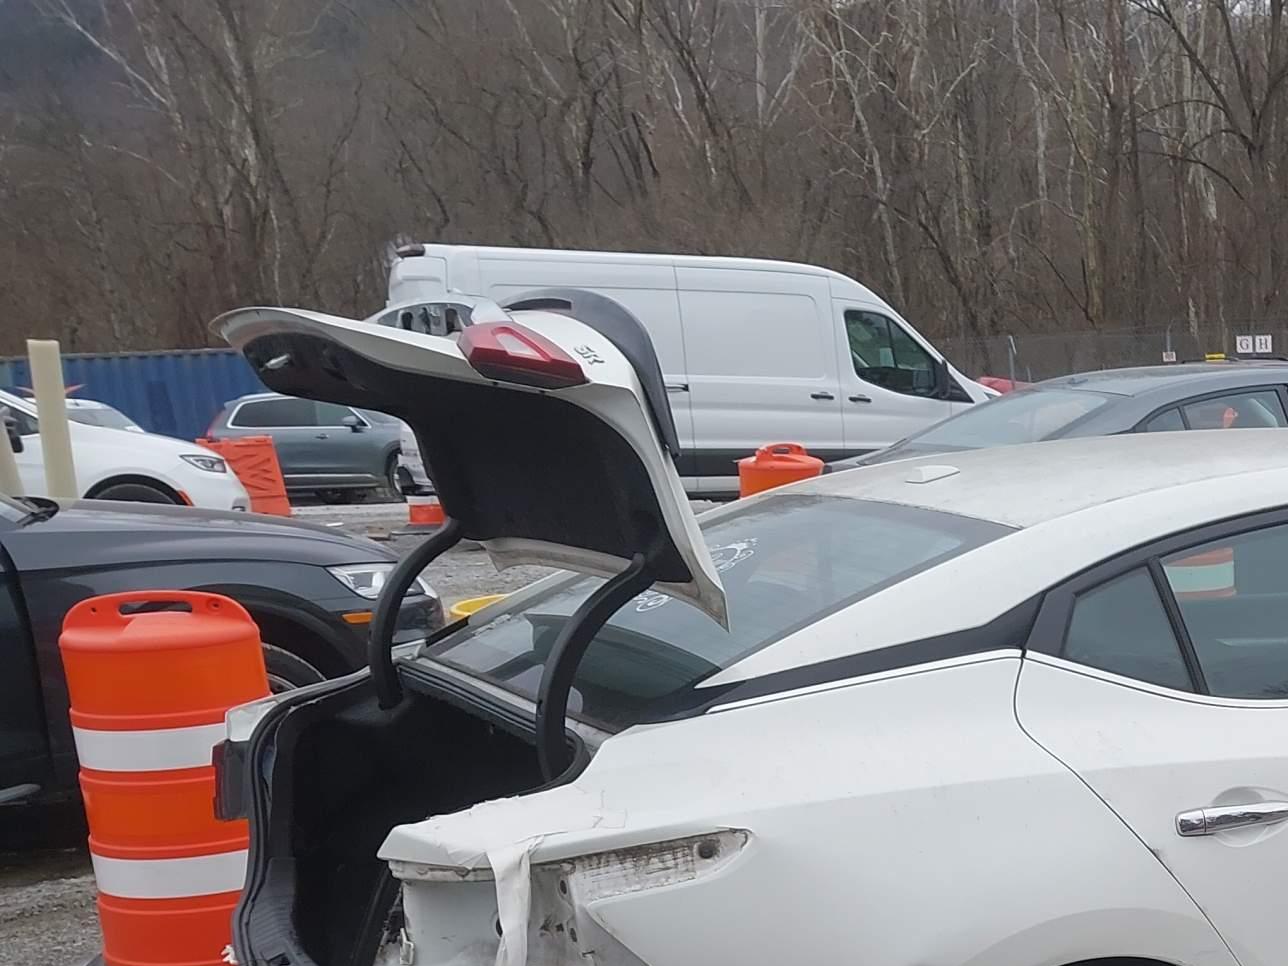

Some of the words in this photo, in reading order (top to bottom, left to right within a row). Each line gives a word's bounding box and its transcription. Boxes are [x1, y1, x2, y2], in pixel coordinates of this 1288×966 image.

[1239, 338, 1250, 350] G
[1258, 337, 1269, 350] H
[574, 344, 605, 365] SR
